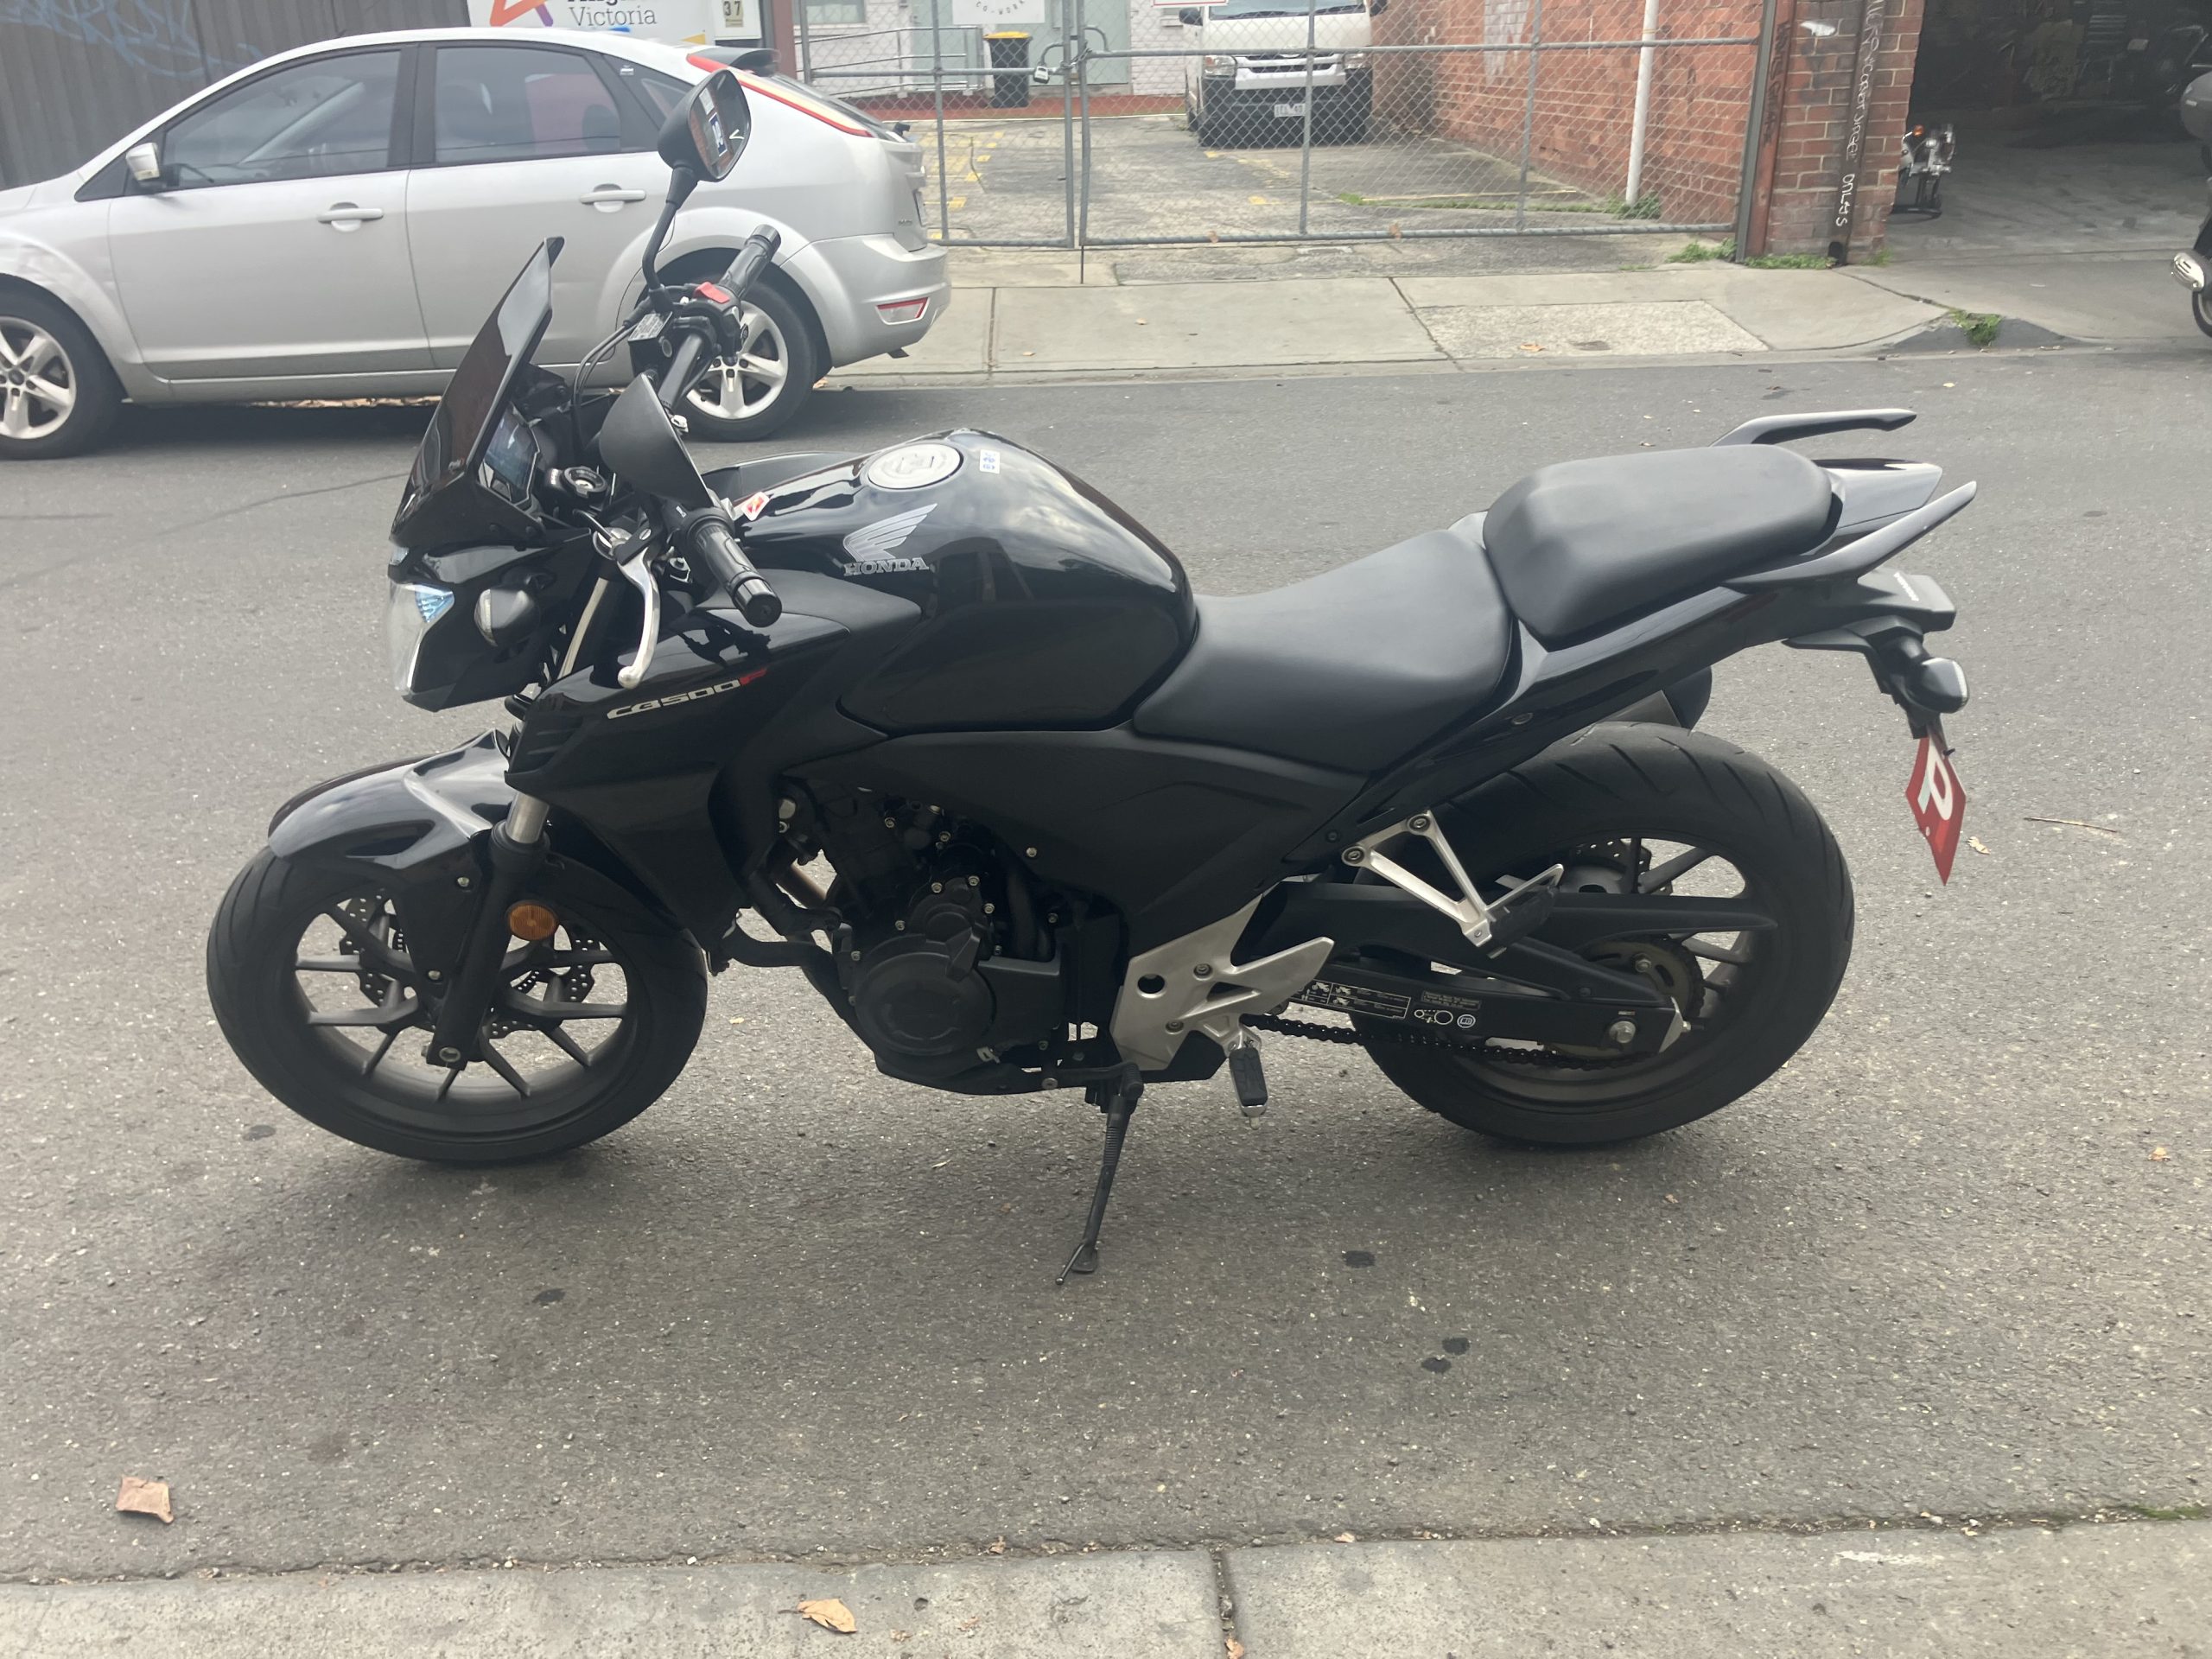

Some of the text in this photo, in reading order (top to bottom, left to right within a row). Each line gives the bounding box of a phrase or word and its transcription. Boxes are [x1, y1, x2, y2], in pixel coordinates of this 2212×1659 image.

[568, 5, 657, 26] Victoria
[724, 0, 741, 16] 37
[843, 556, 930, 576] HONDA
[607, 667, 767, 720] CB500F
